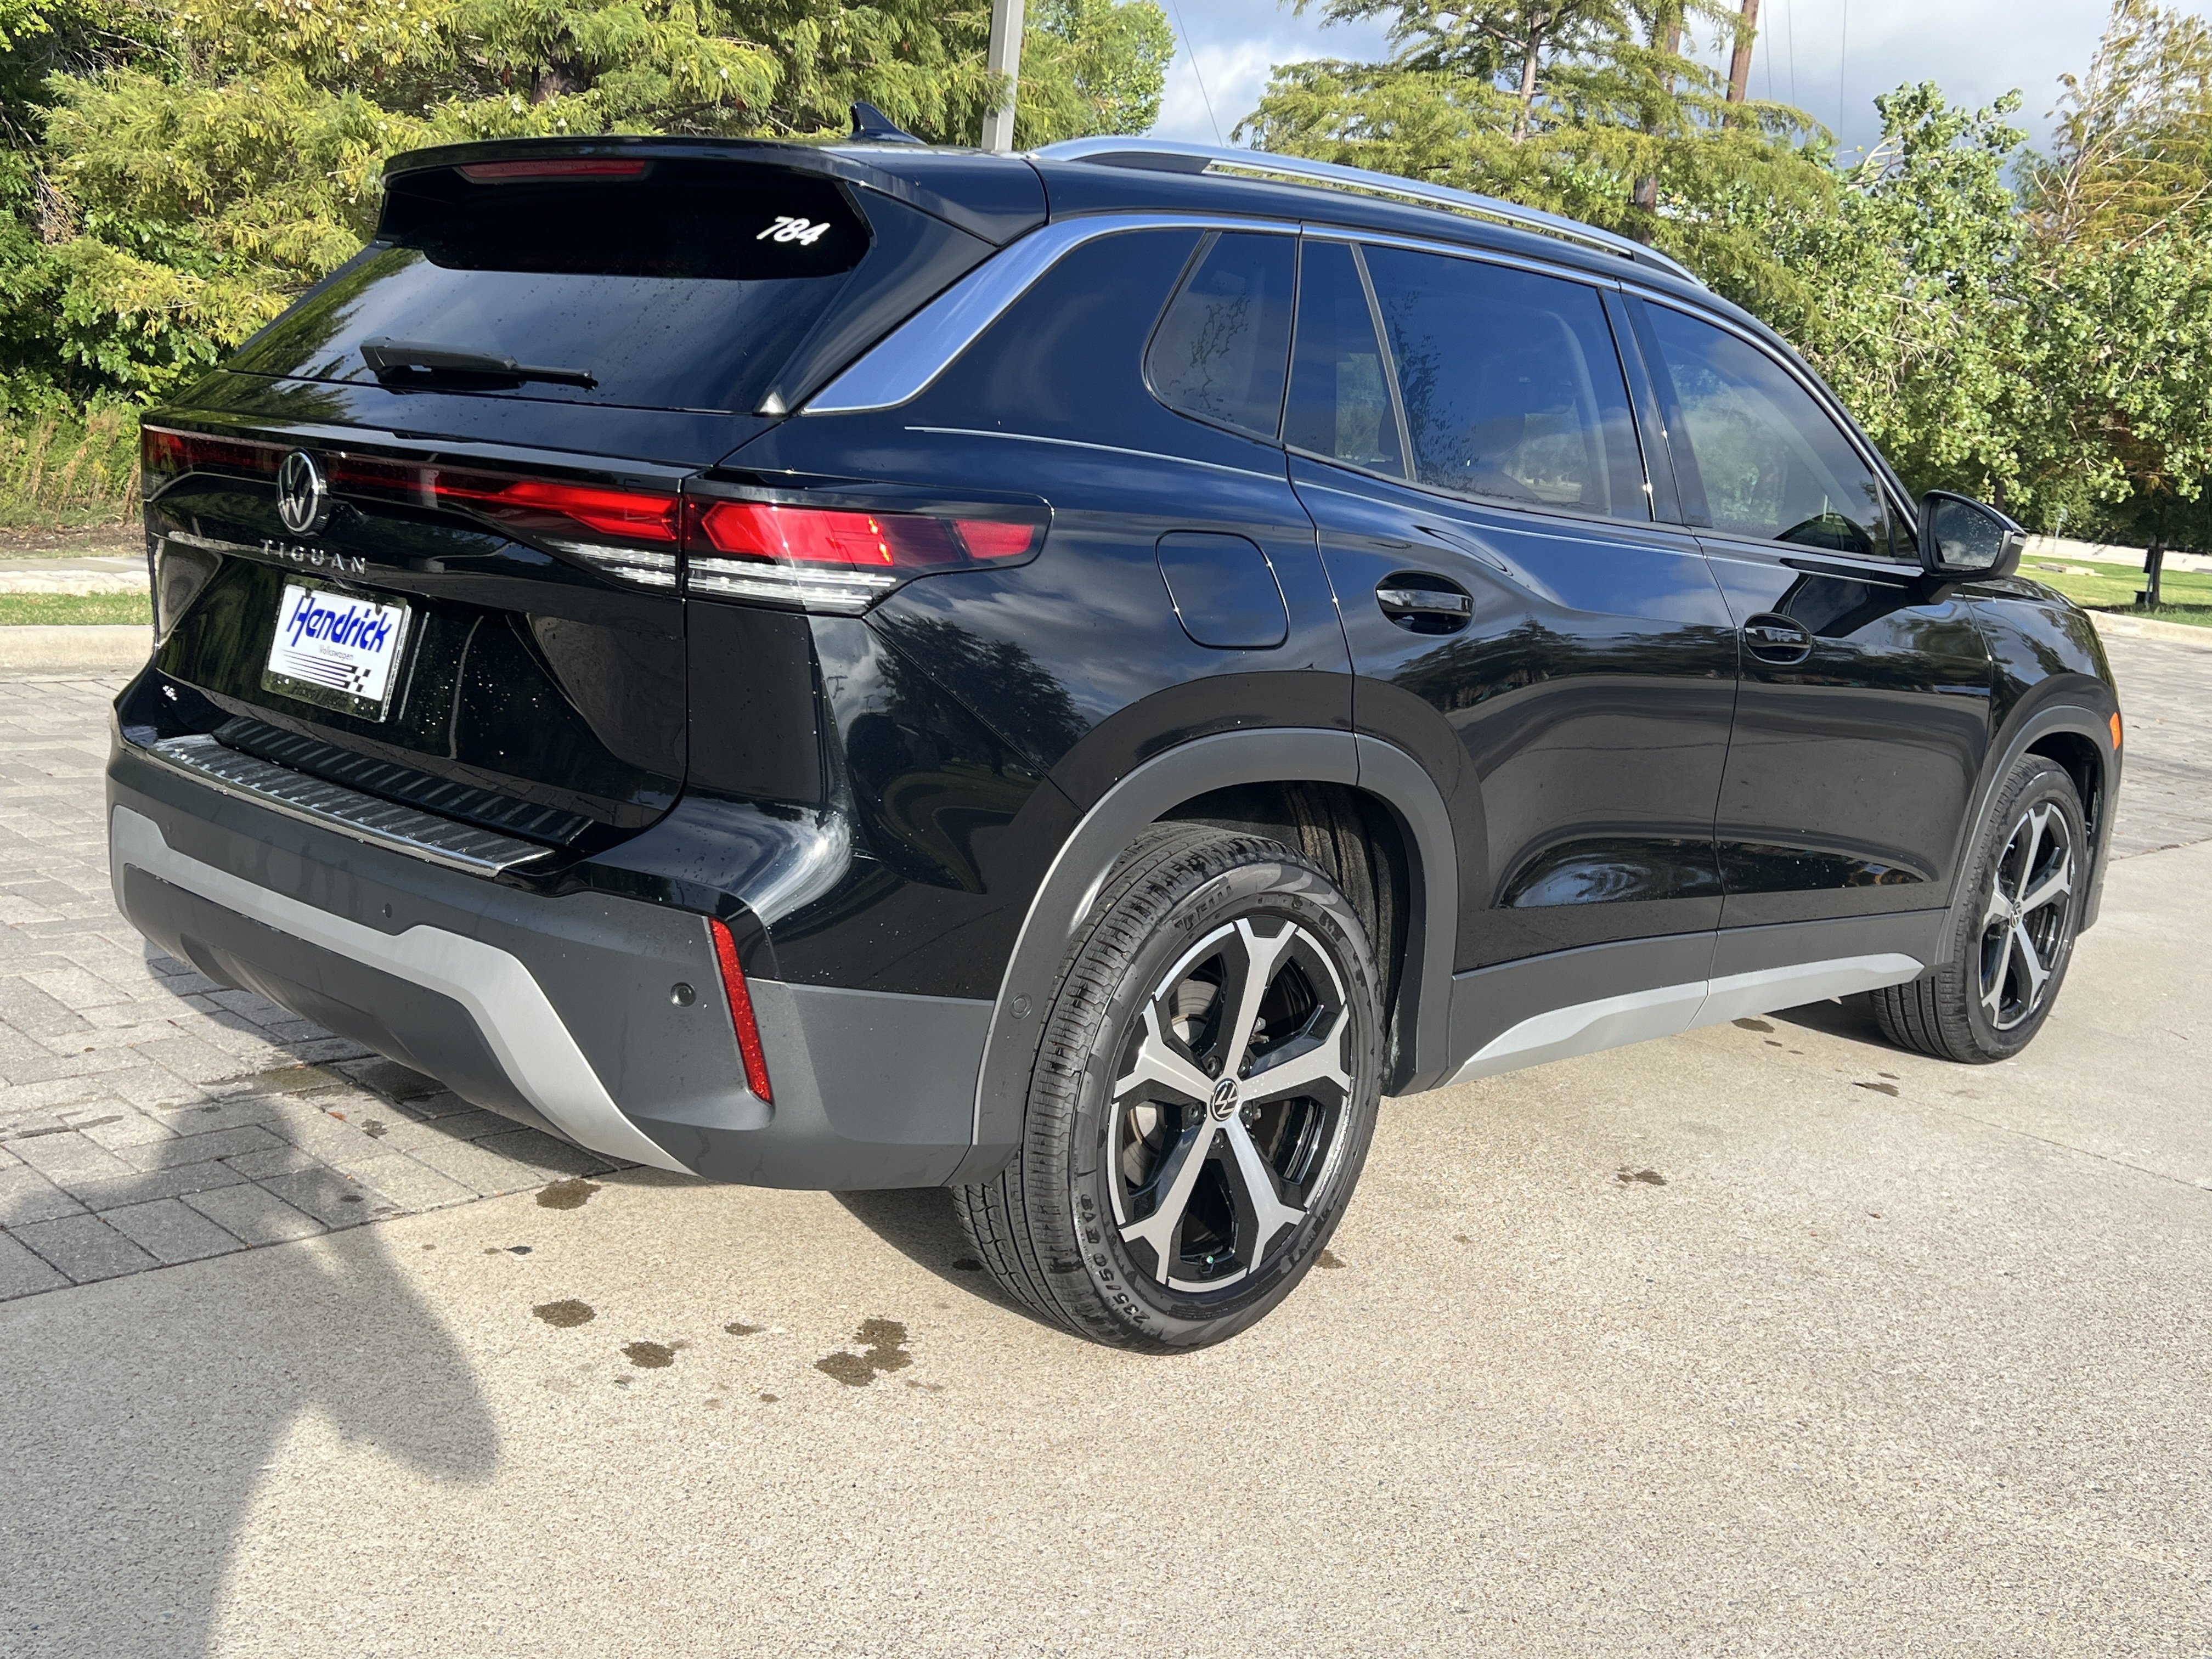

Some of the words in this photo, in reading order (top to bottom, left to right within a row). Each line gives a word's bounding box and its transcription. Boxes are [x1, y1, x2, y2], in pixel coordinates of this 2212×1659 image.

[756, 216, 831, 246] 784
[260, 539, 366, 575] TIGUAN
[286, 595, 392, 653] Hendrick
